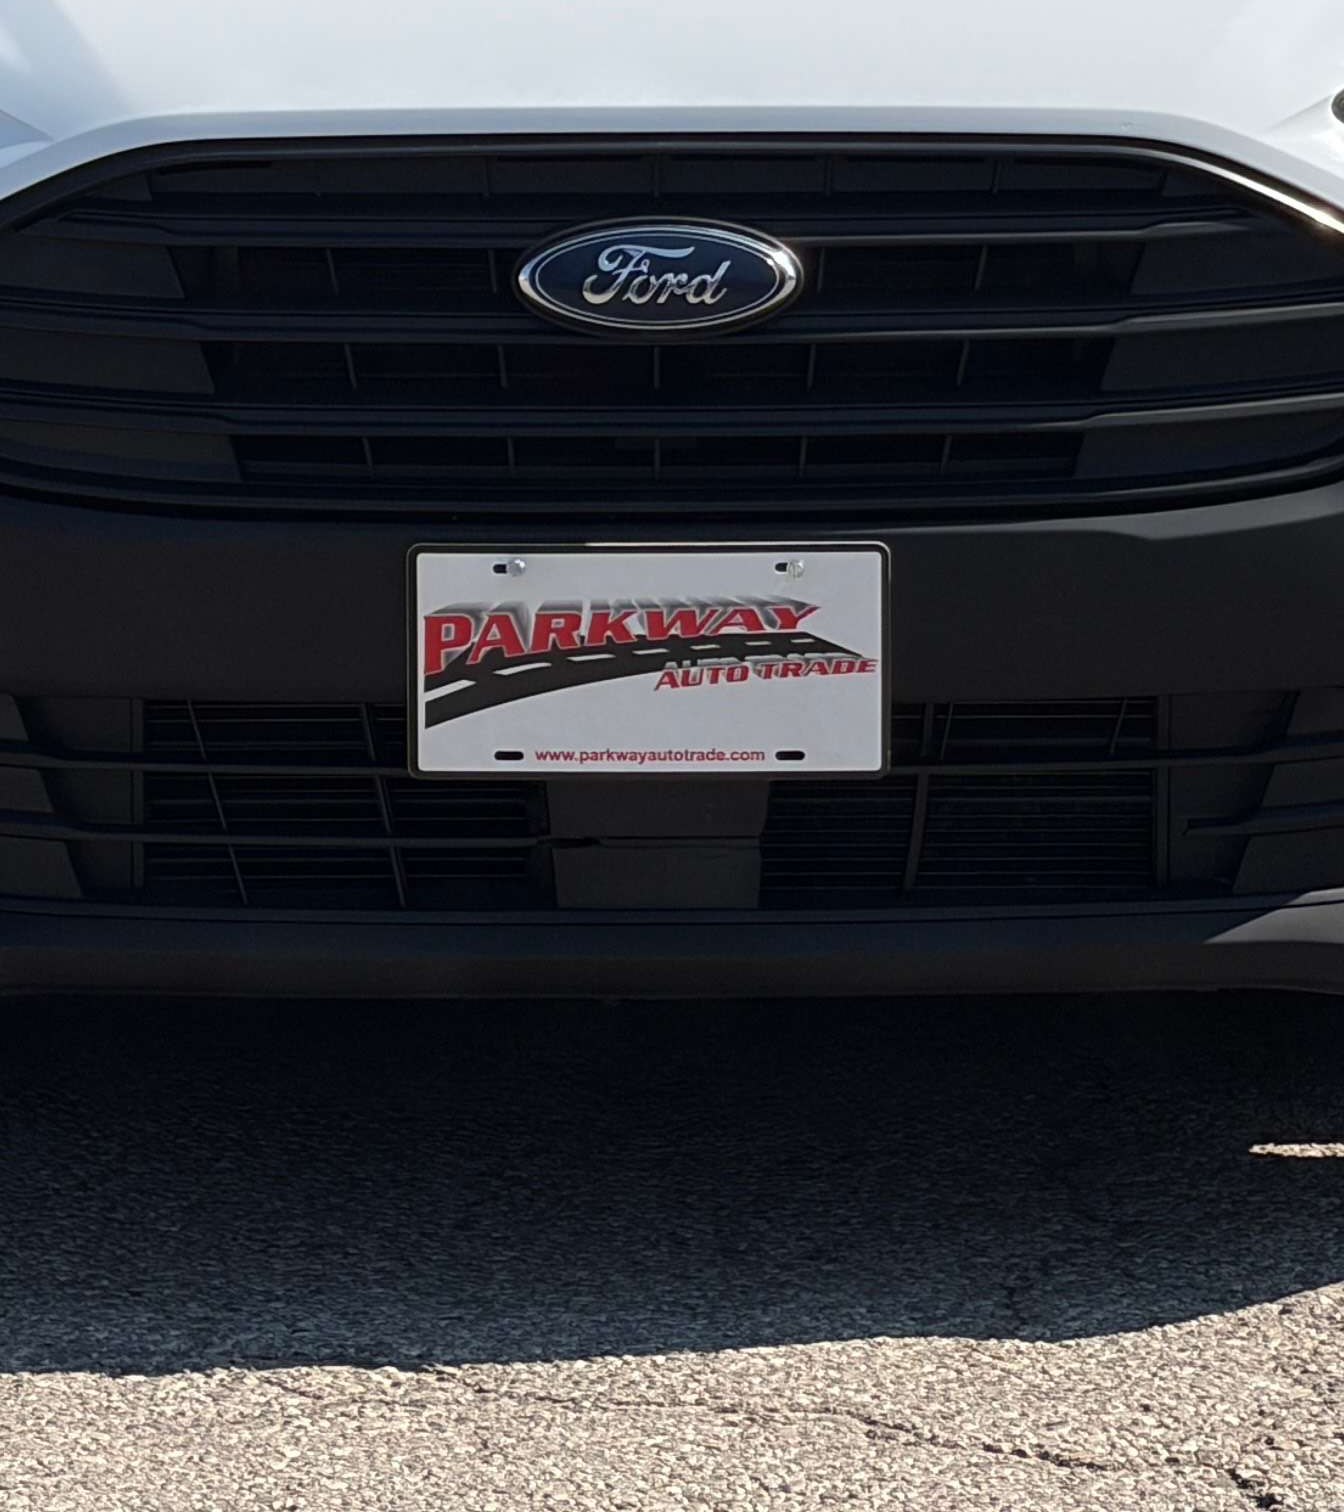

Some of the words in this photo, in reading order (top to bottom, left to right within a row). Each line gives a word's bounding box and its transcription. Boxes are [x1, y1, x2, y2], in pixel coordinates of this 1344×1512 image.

[582, 243, 732, 305] Ford
[423, 602, 822, 676] PARKWAY
[654, 662, 751, 691] AUTO
[758, 656, 879, 680] TRADE
[534, 748, 766, 765] www.parkwayautotrade.com
